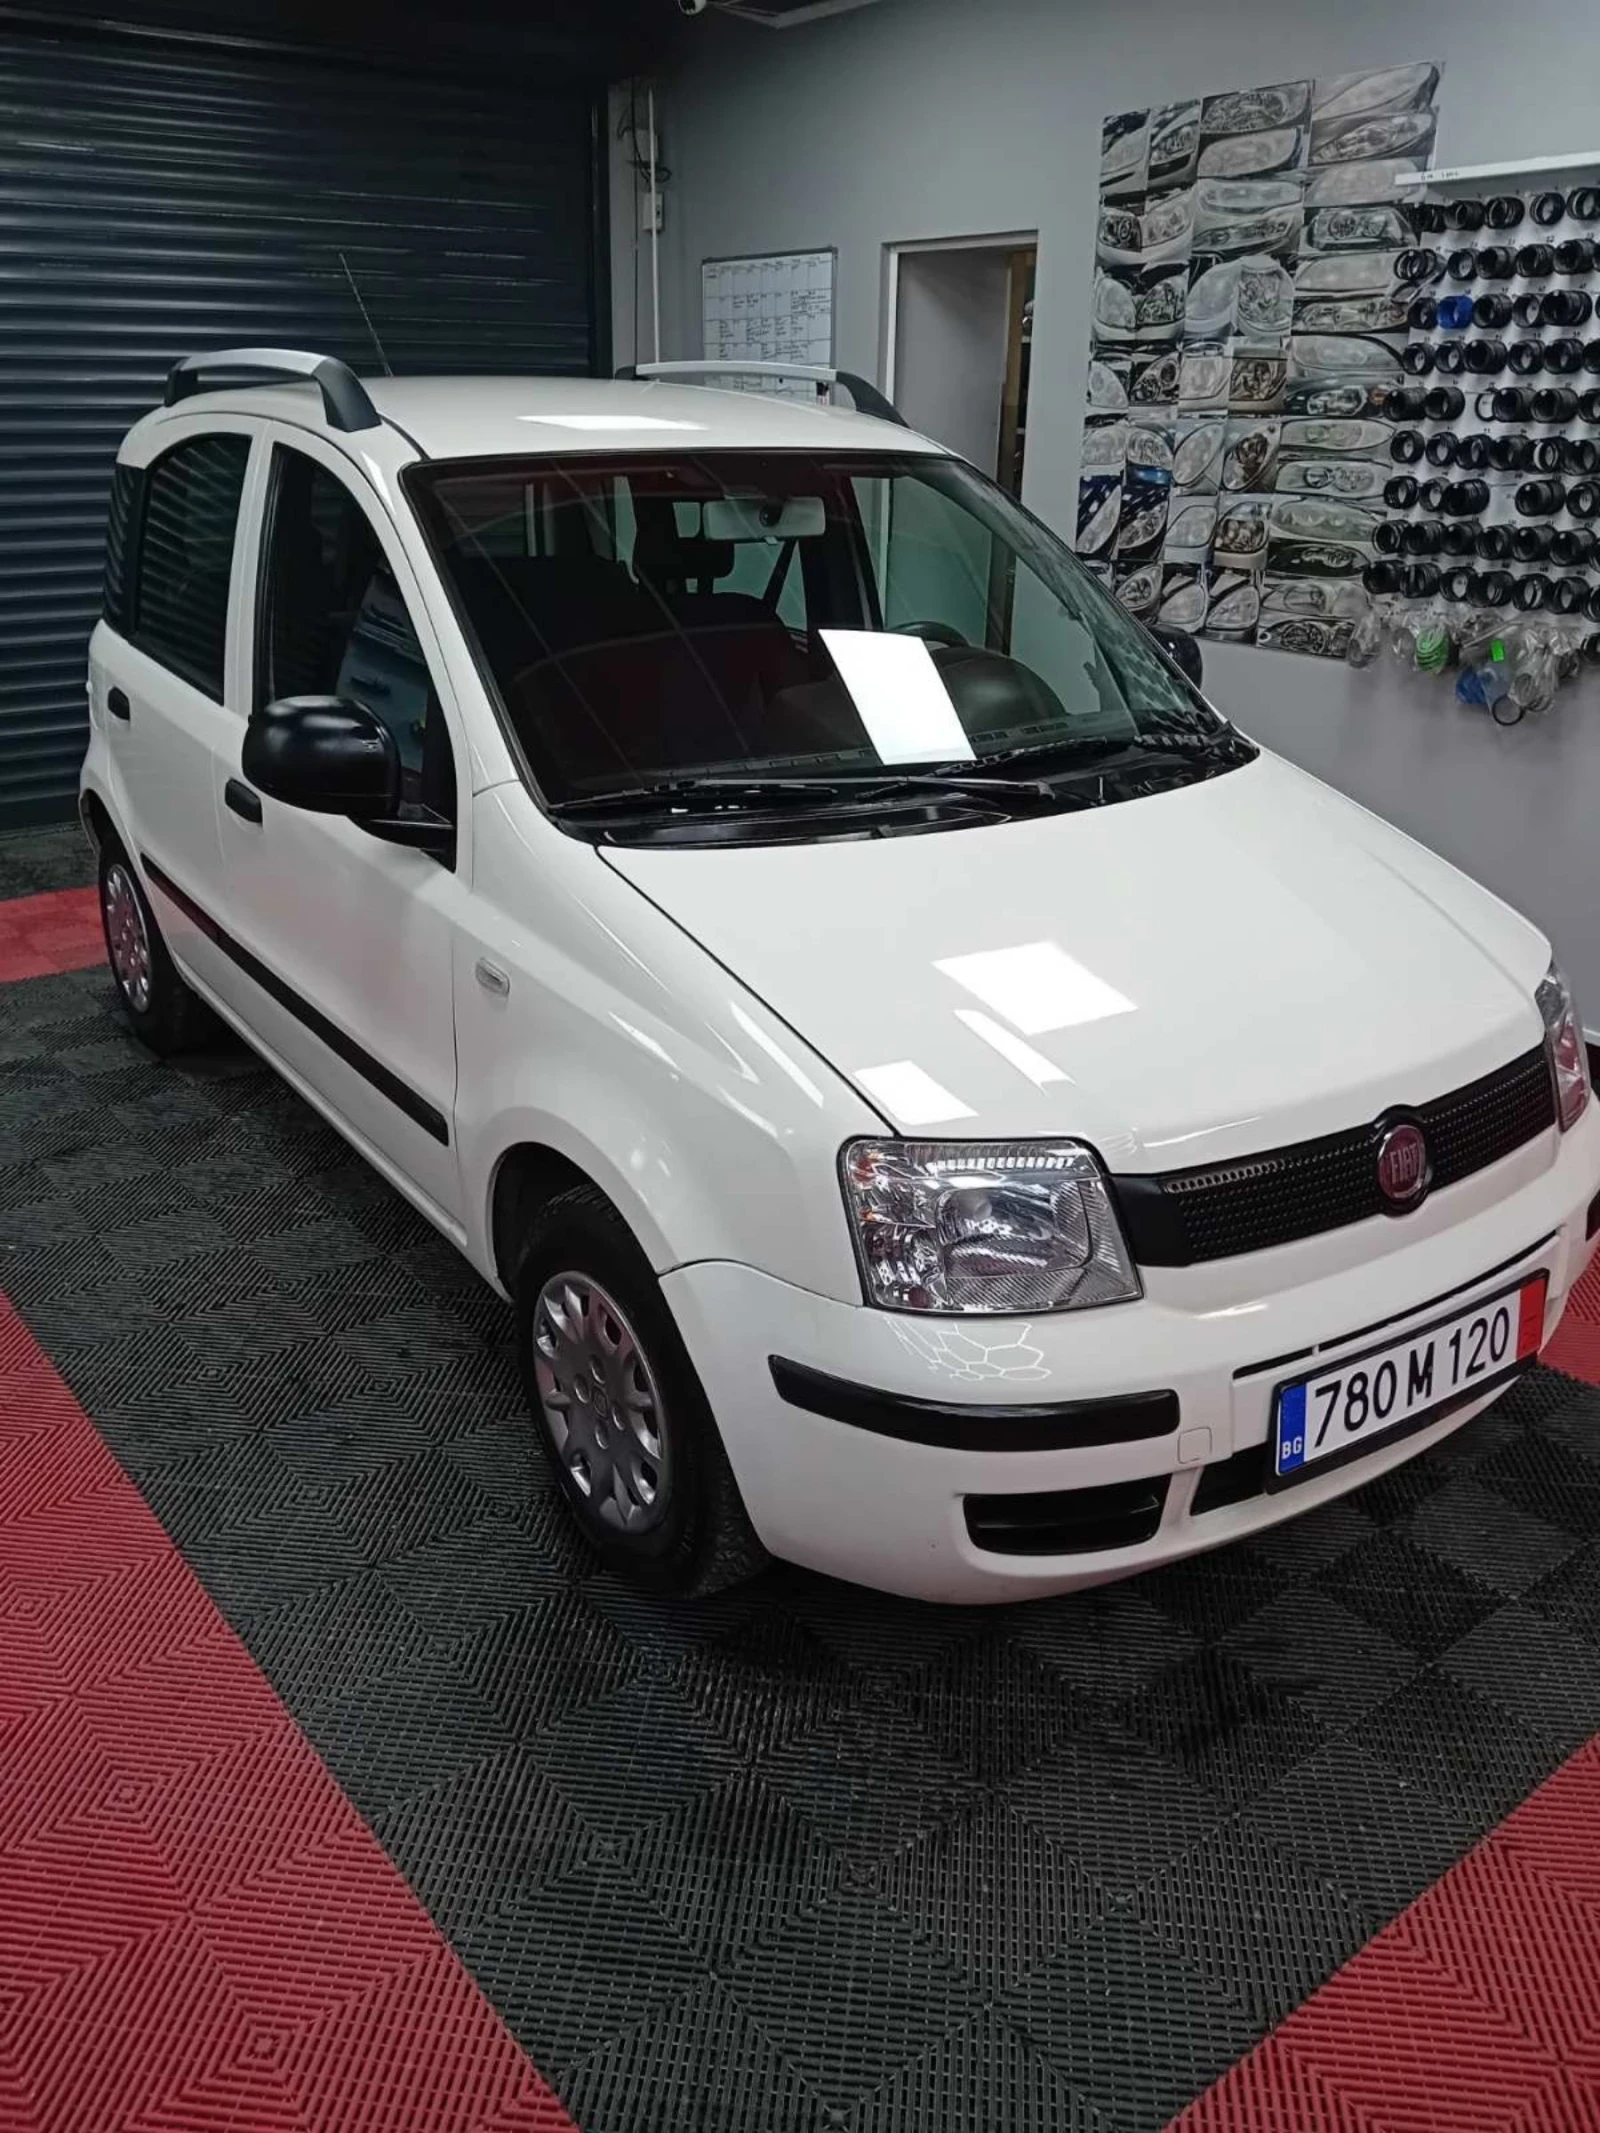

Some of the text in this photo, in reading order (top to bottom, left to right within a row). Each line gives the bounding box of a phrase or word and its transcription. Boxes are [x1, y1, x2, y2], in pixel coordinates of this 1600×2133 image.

[1389, 1142, 1418, 1185] FIAT
[1314, 1306, 1510, 1448] 780 M 120
[1281, 1437, 1302, 1460] BG
